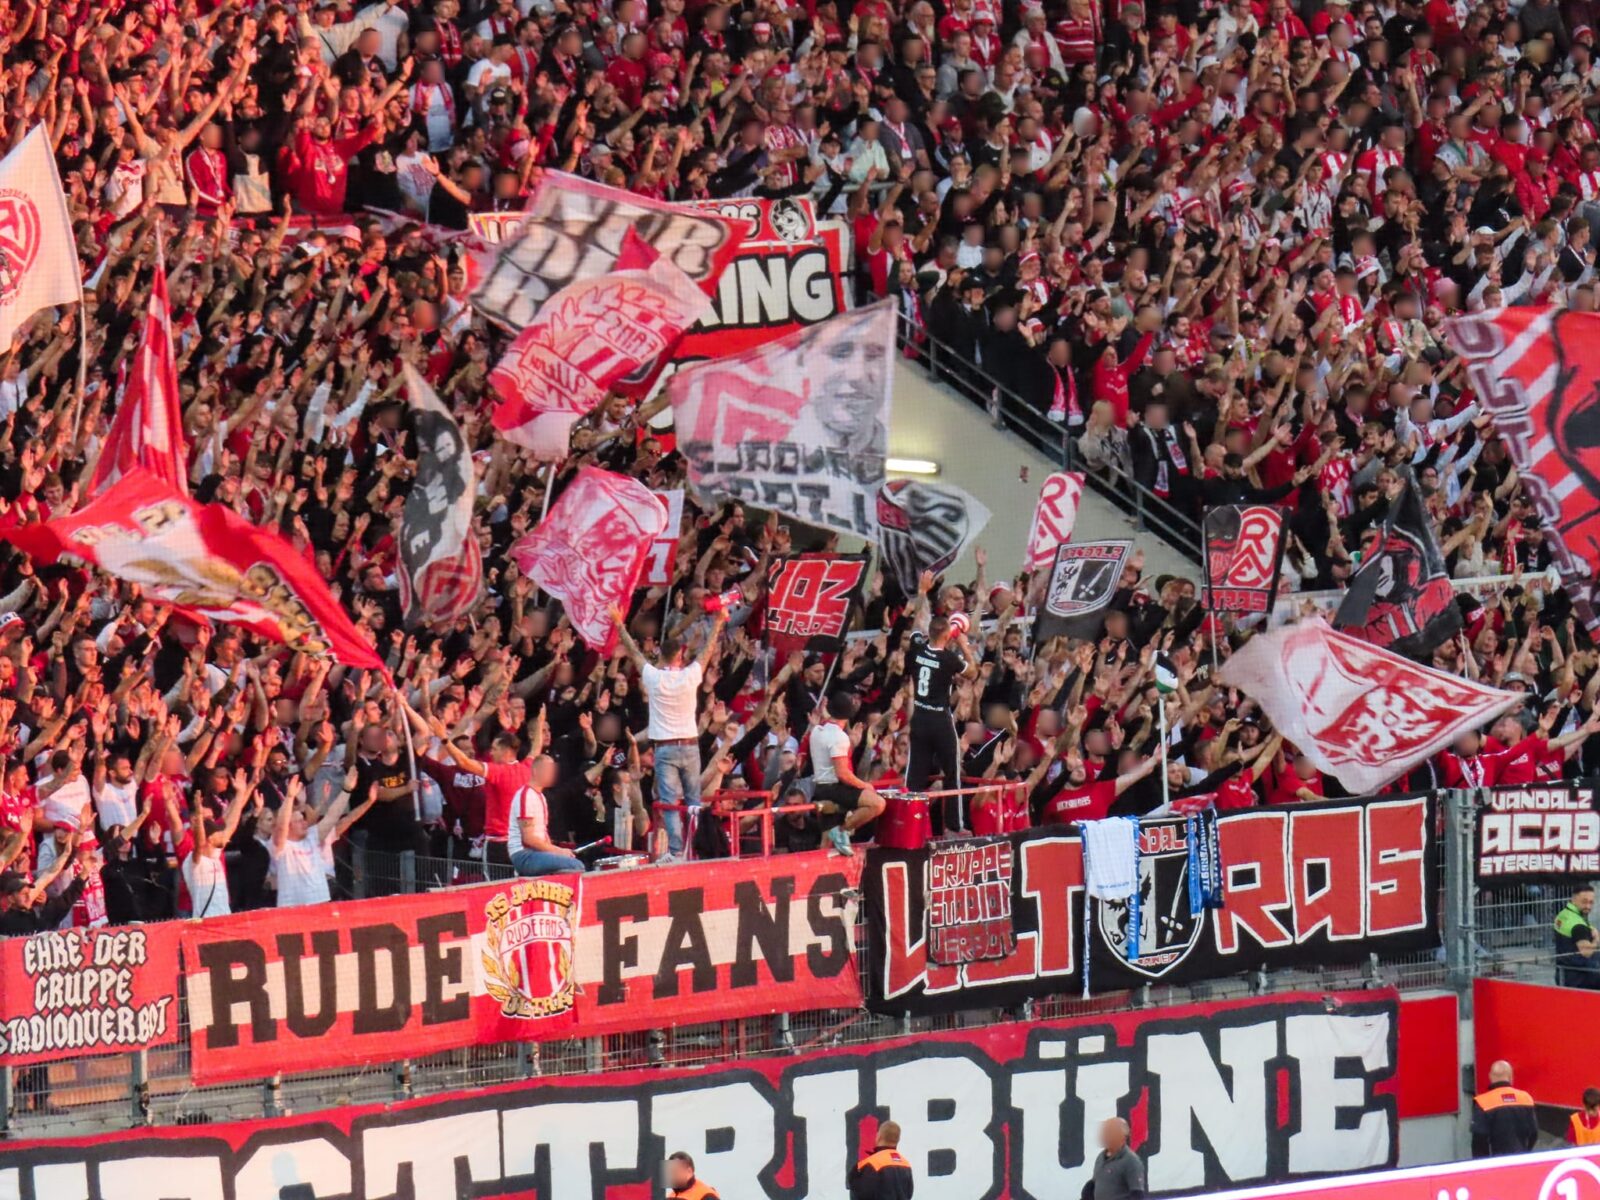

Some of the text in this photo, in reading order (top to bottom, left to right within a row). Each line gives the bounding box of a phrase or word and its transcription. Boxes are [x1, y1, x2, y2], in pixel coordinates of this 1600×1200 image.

[699, 252, 837, 327] ING
[918, 666, 931, 697] 8
[1491, 789, 1592, 810] VANDALZ
[1482, 812, 1600, 852] ACAB
[930, 842, 1012, 890] GRUPPE
[1480, 853, 1600, 875] STERBEN NIE
[511, 880, 574, 907] JAHRE
[930, 881, 1012, 927] STADION
[24, 930, 147, 975] EHRE DER
[199, 872, 850, 1049] RUDE FANS
[930, 919, 1017, 963] VERBOT
[34, 968, 133, 1011] GRUPPE
